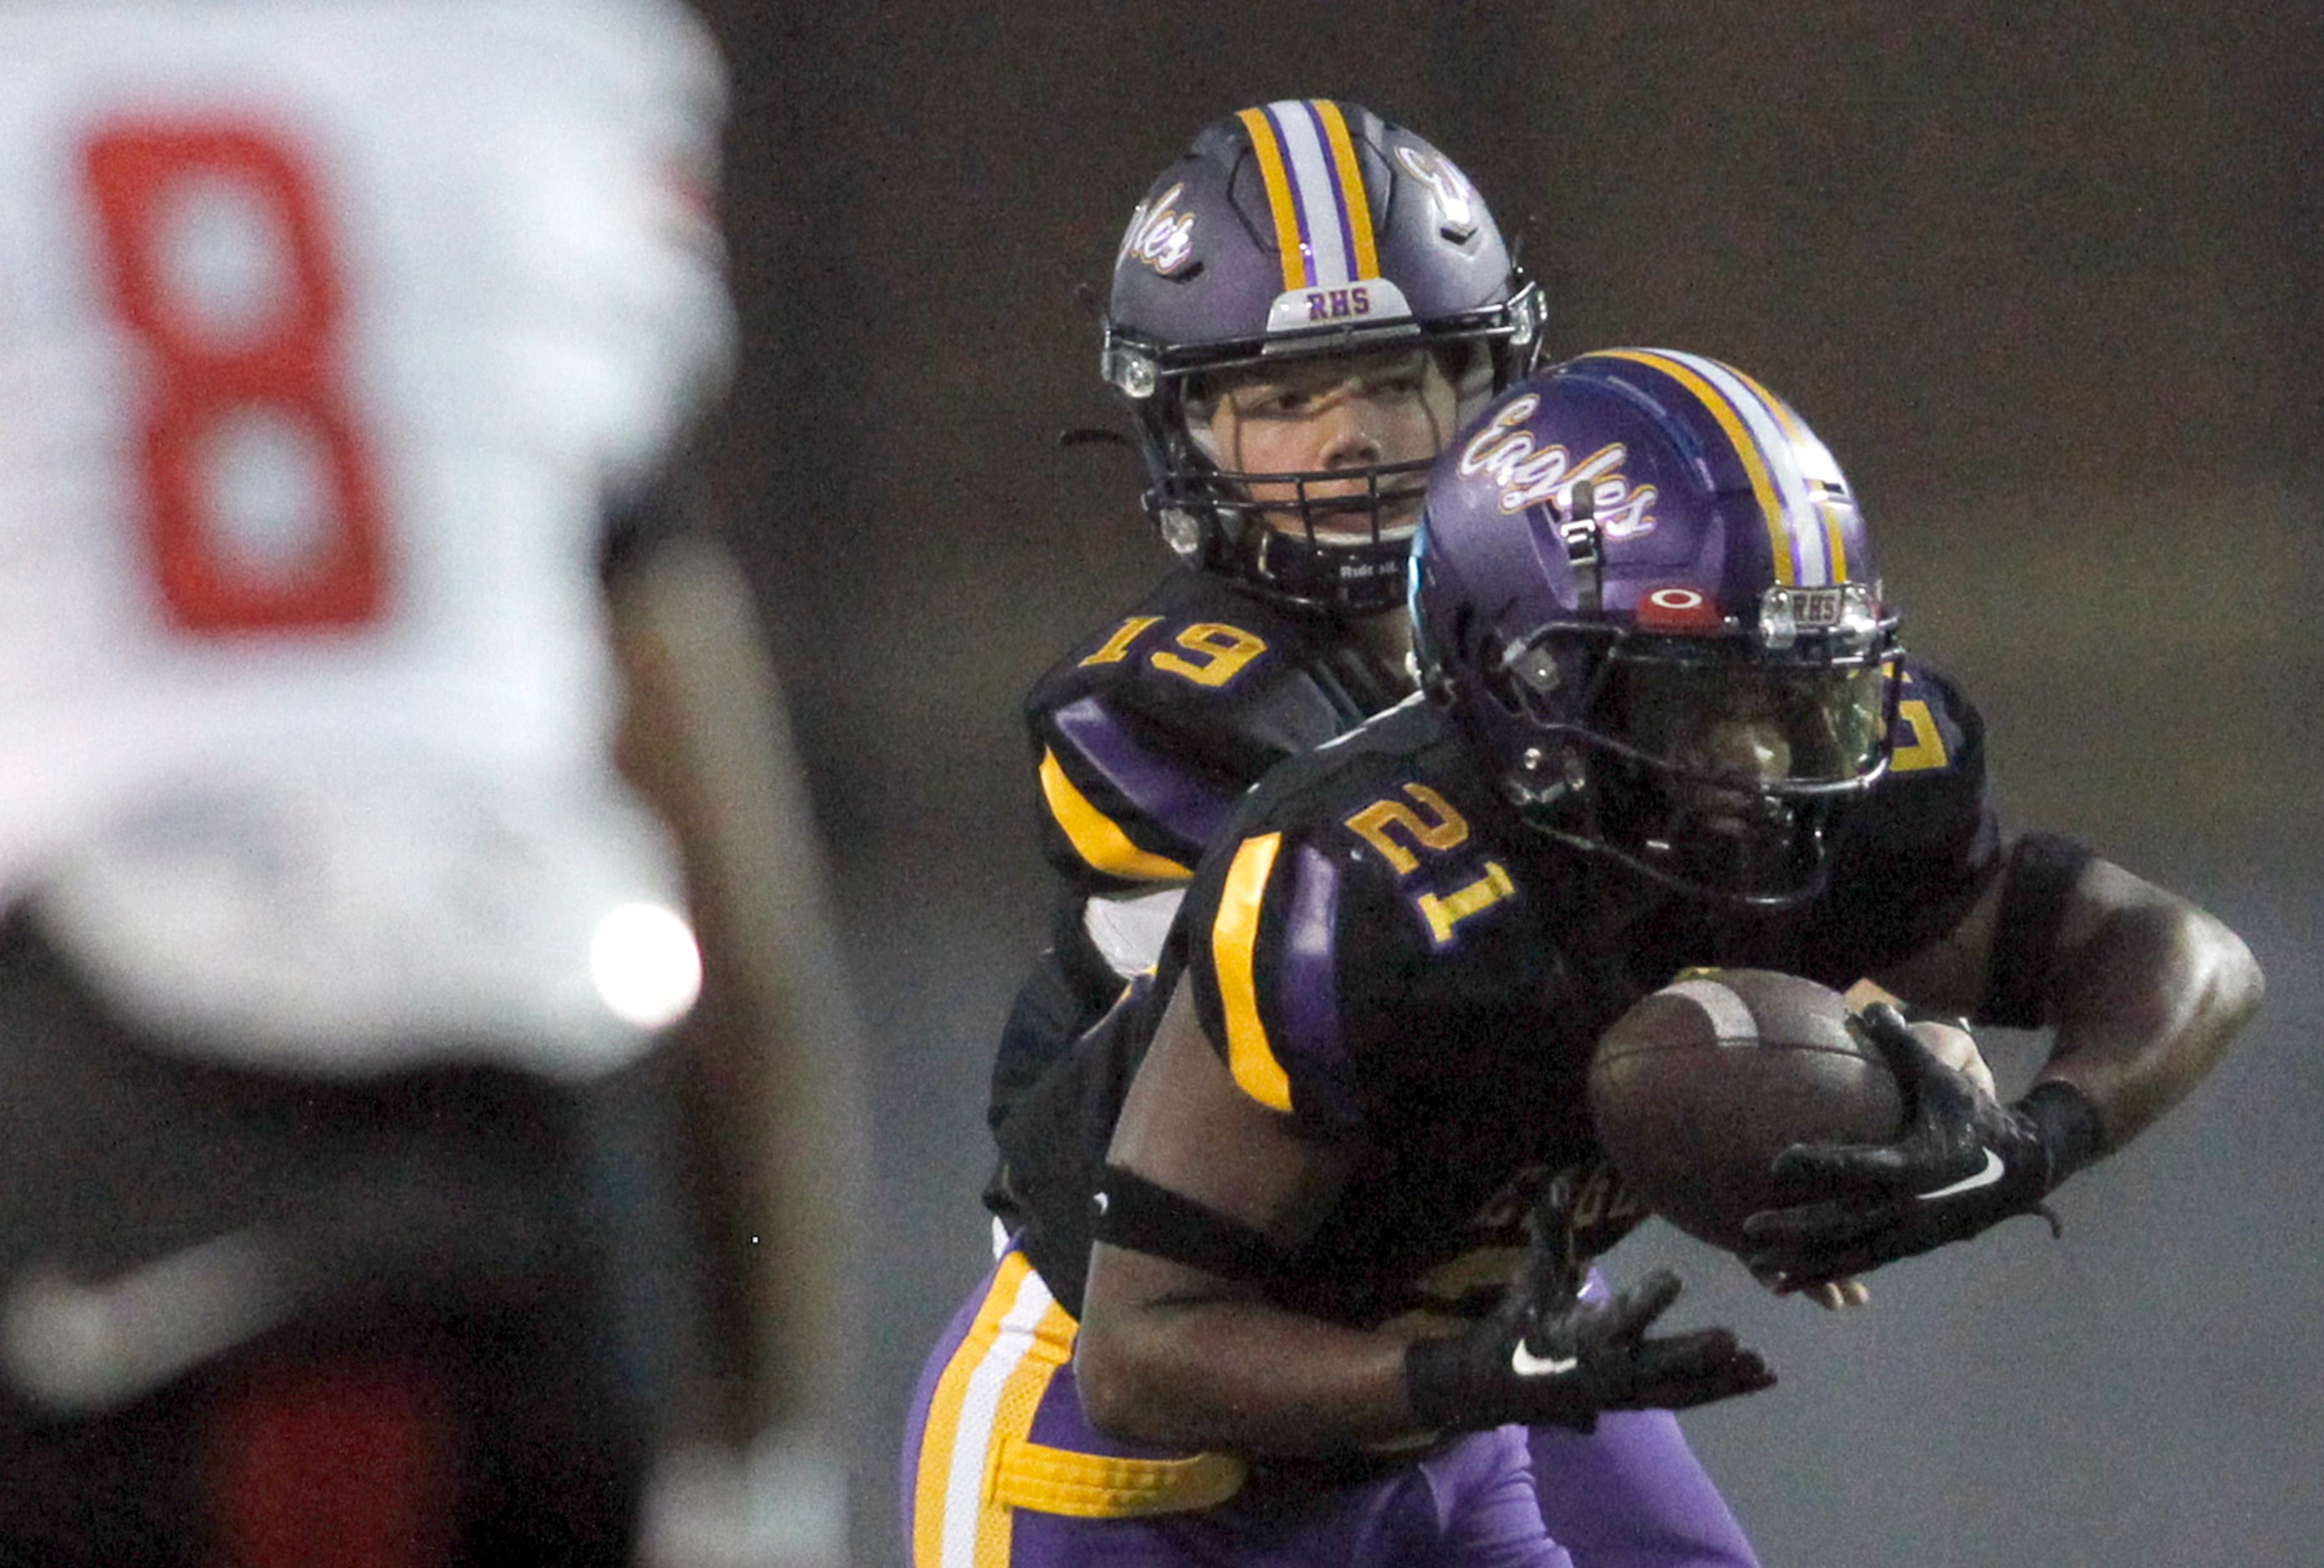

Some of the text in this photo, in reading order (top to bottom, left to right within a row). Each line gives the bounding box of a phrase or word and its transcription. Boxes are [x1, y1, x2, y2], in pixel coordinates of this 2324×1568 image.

[1308, 287, 1370, 321] RHS
[82, 115, 391, 643] 8
[1456, 393, 1659, 541] Eagles
[1077, 616, 1268, 687] 19
[1792, 592, 1837, 623] RHS
[1344, 782, 1516, 943] 21
